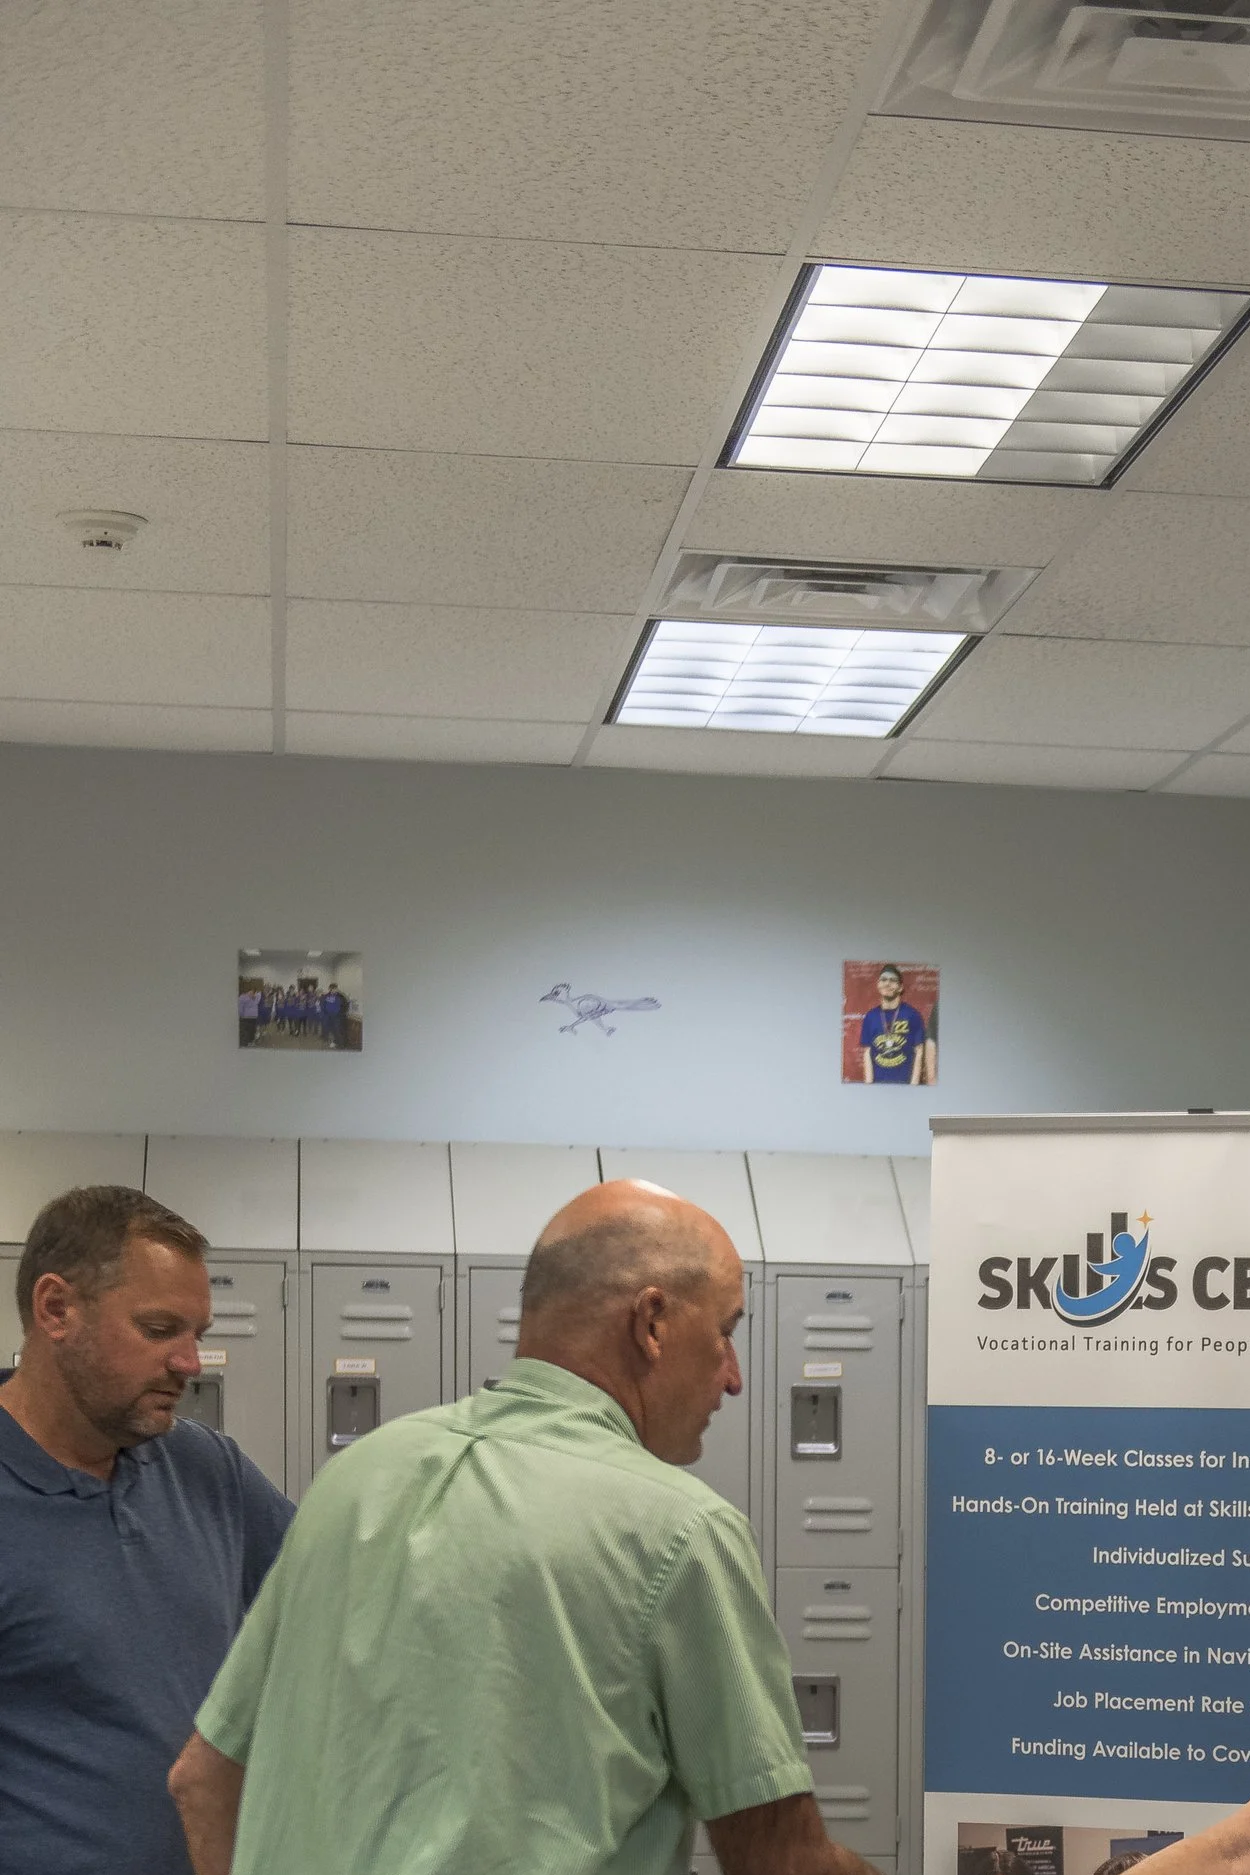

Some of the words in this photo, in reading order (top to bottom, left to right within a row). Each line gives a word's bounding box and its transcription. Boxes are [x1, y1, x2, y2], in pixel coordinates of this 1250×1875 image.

[977, 1336, 1074, 1350] Vocational
[1084, 1337, 1158, 1355] Training
[1167, 1336, 1193, 1351] for
[985, 1448, 1003, 1464] 8-
[1011, 1453, 1029, 1465] or
[1037, 1449, 1118, 1466] 16-Week
[1124, 1450, 1193, 1467] Classes
[1200, 1451, 1225, 1468] for
[953, 1496, 1049, 1513] Hands-On
[1056, 1498, 1128, 1519] Training
[1136, 1499, 1176, 1516] Held
[1184, 1500, 1203, 1516] at
[1094, 1547, 1224, 1566] Individualized
[1036, 1594, 1150, 1615] Competitive
[1004, 1642, 1072, 1659] On-Site
[1079, 1644, 1177, 1662] Assistance
[1184, 1647, 1199, 1663] in
[1054, 1691, 1087, 1708] Job
[1095, 1693, 1194, 1711] Placement
[1202, 1696, 1244, 1713] Rate
[1012, 1739, 1085, 1760] Funding
[1093, 1741, 1180, 1760] Available
[1187, 1744, 1205, 1761] to
